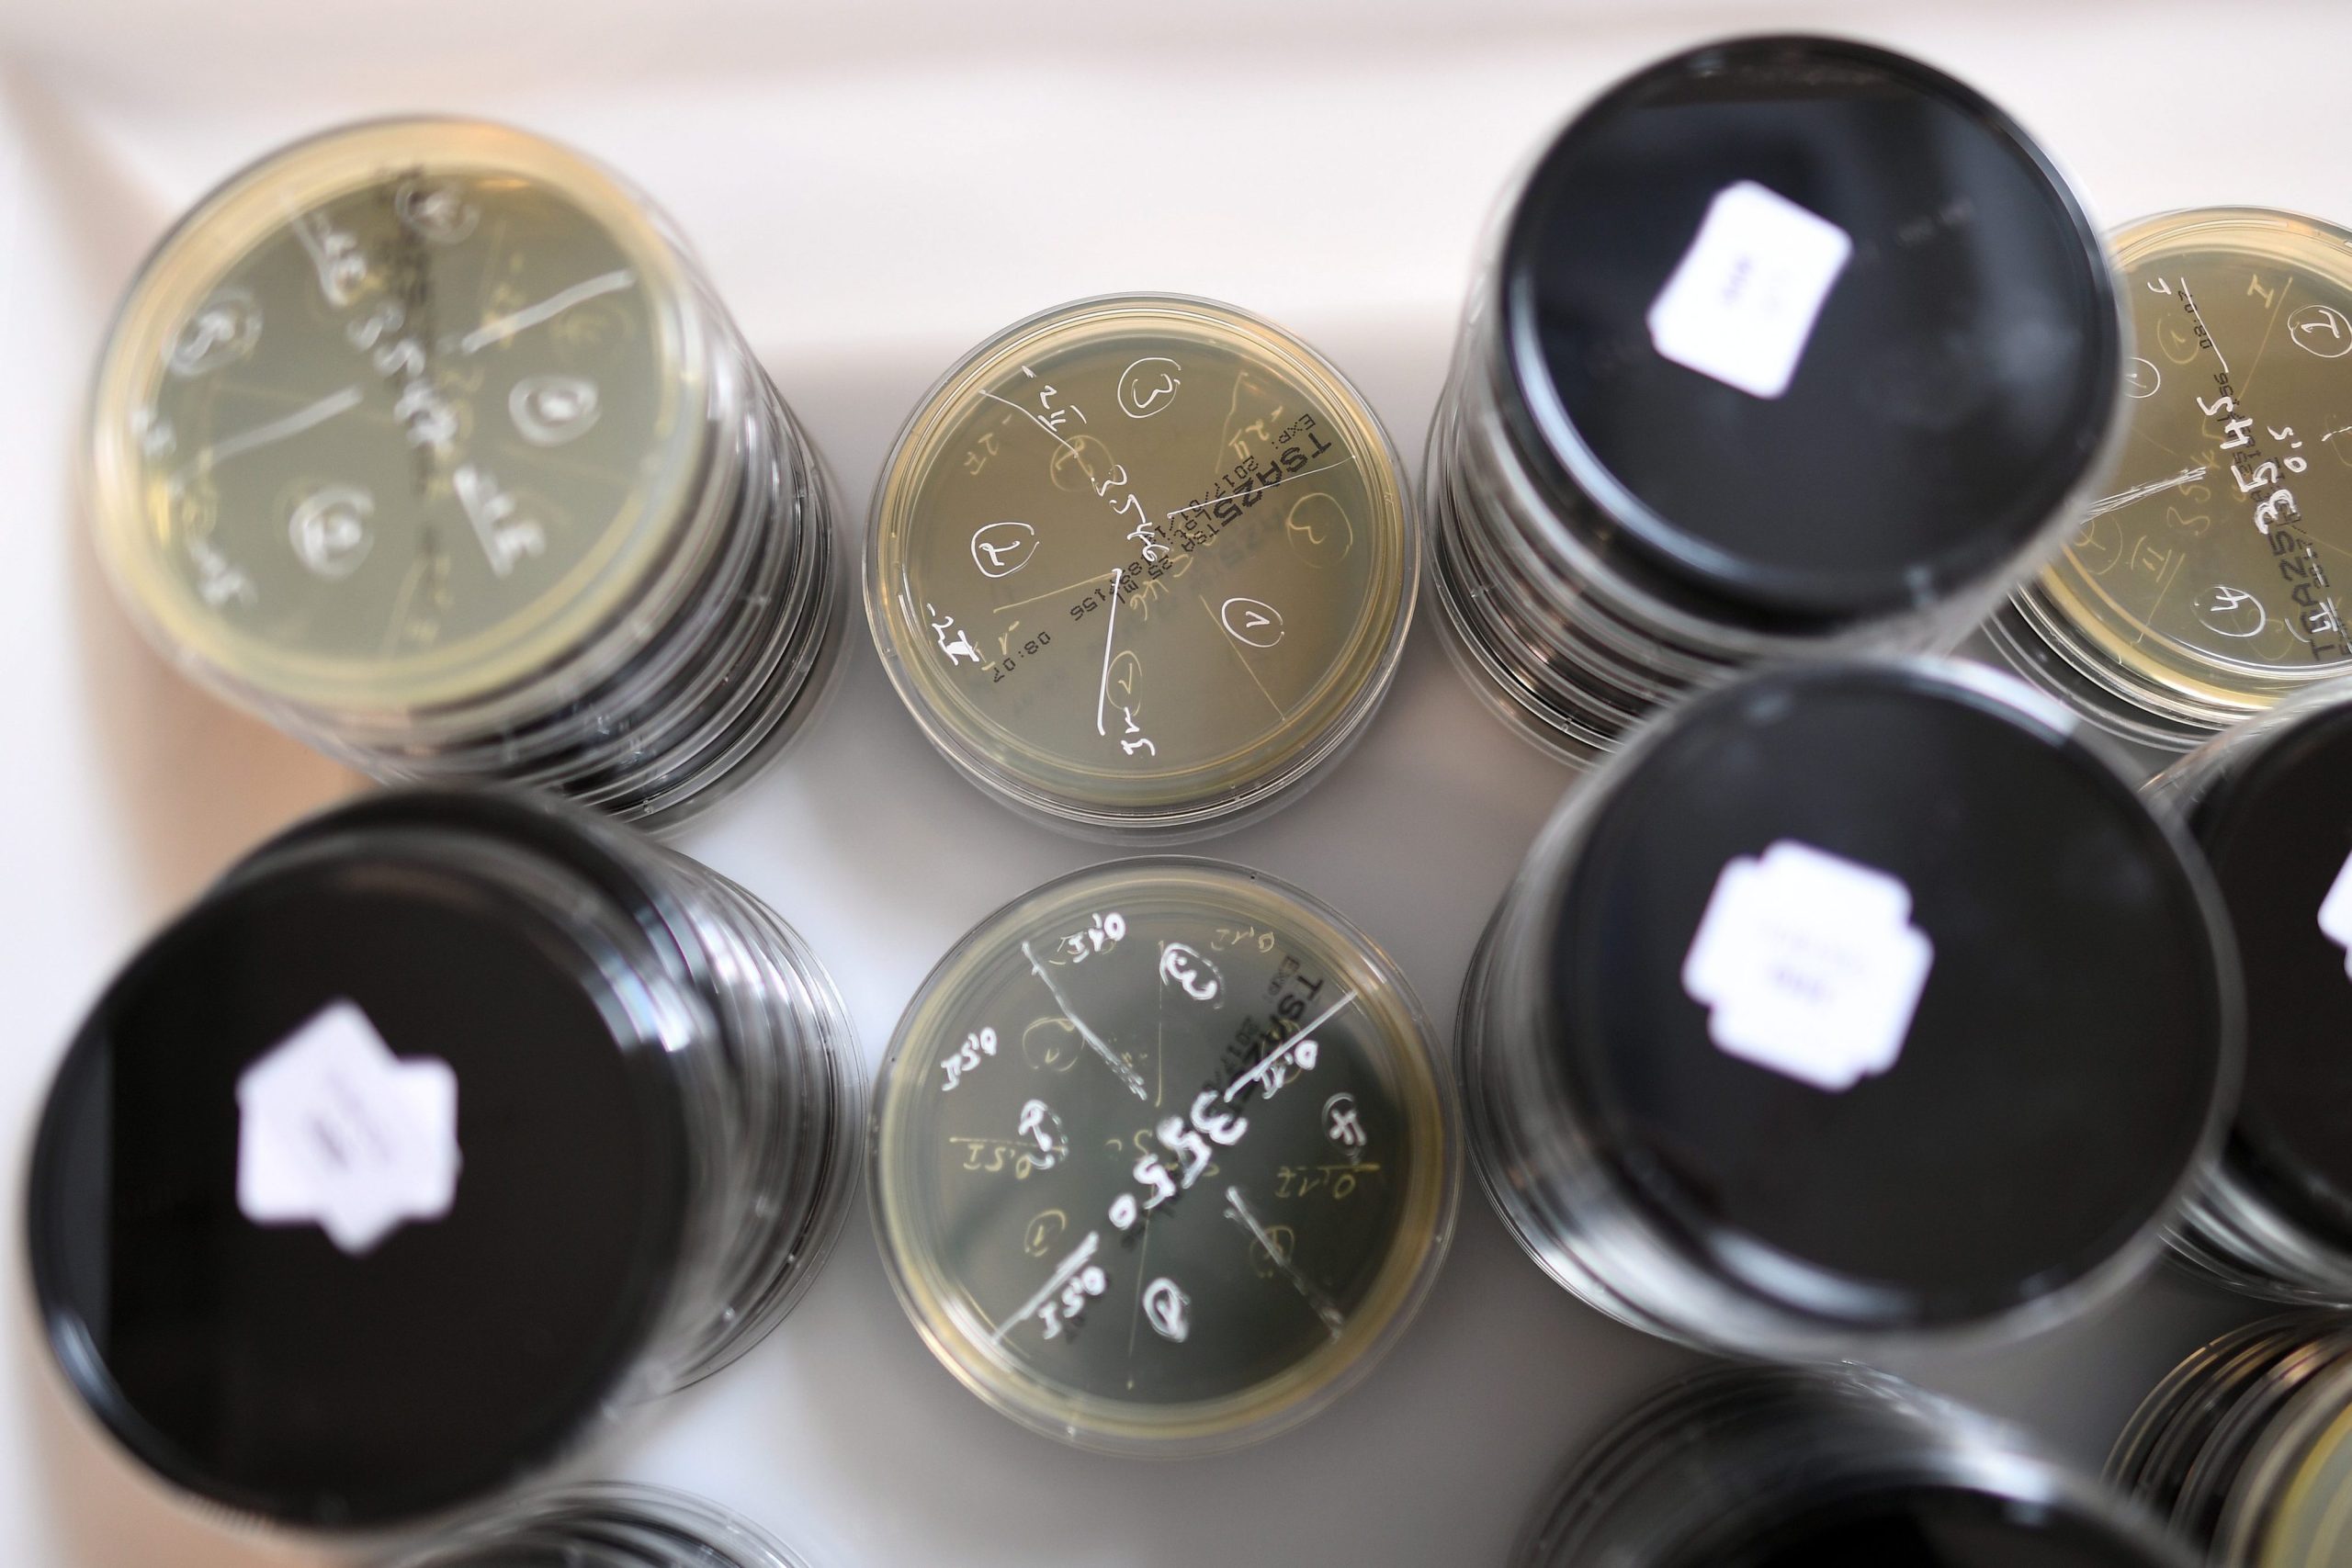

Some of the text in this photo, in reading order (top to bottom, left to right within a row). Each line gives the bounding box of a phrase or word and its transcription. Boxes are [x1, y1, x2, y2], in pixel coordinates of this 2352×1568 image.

[1091, 464, 1170, 562] 3546
[1212, 433, 1333, 527] TSA25
[2197, 397, 2297, 535] 3545
[992, 631, 1051, 683] 08:07
[1108, 1089, 1248, 1231] 3550
